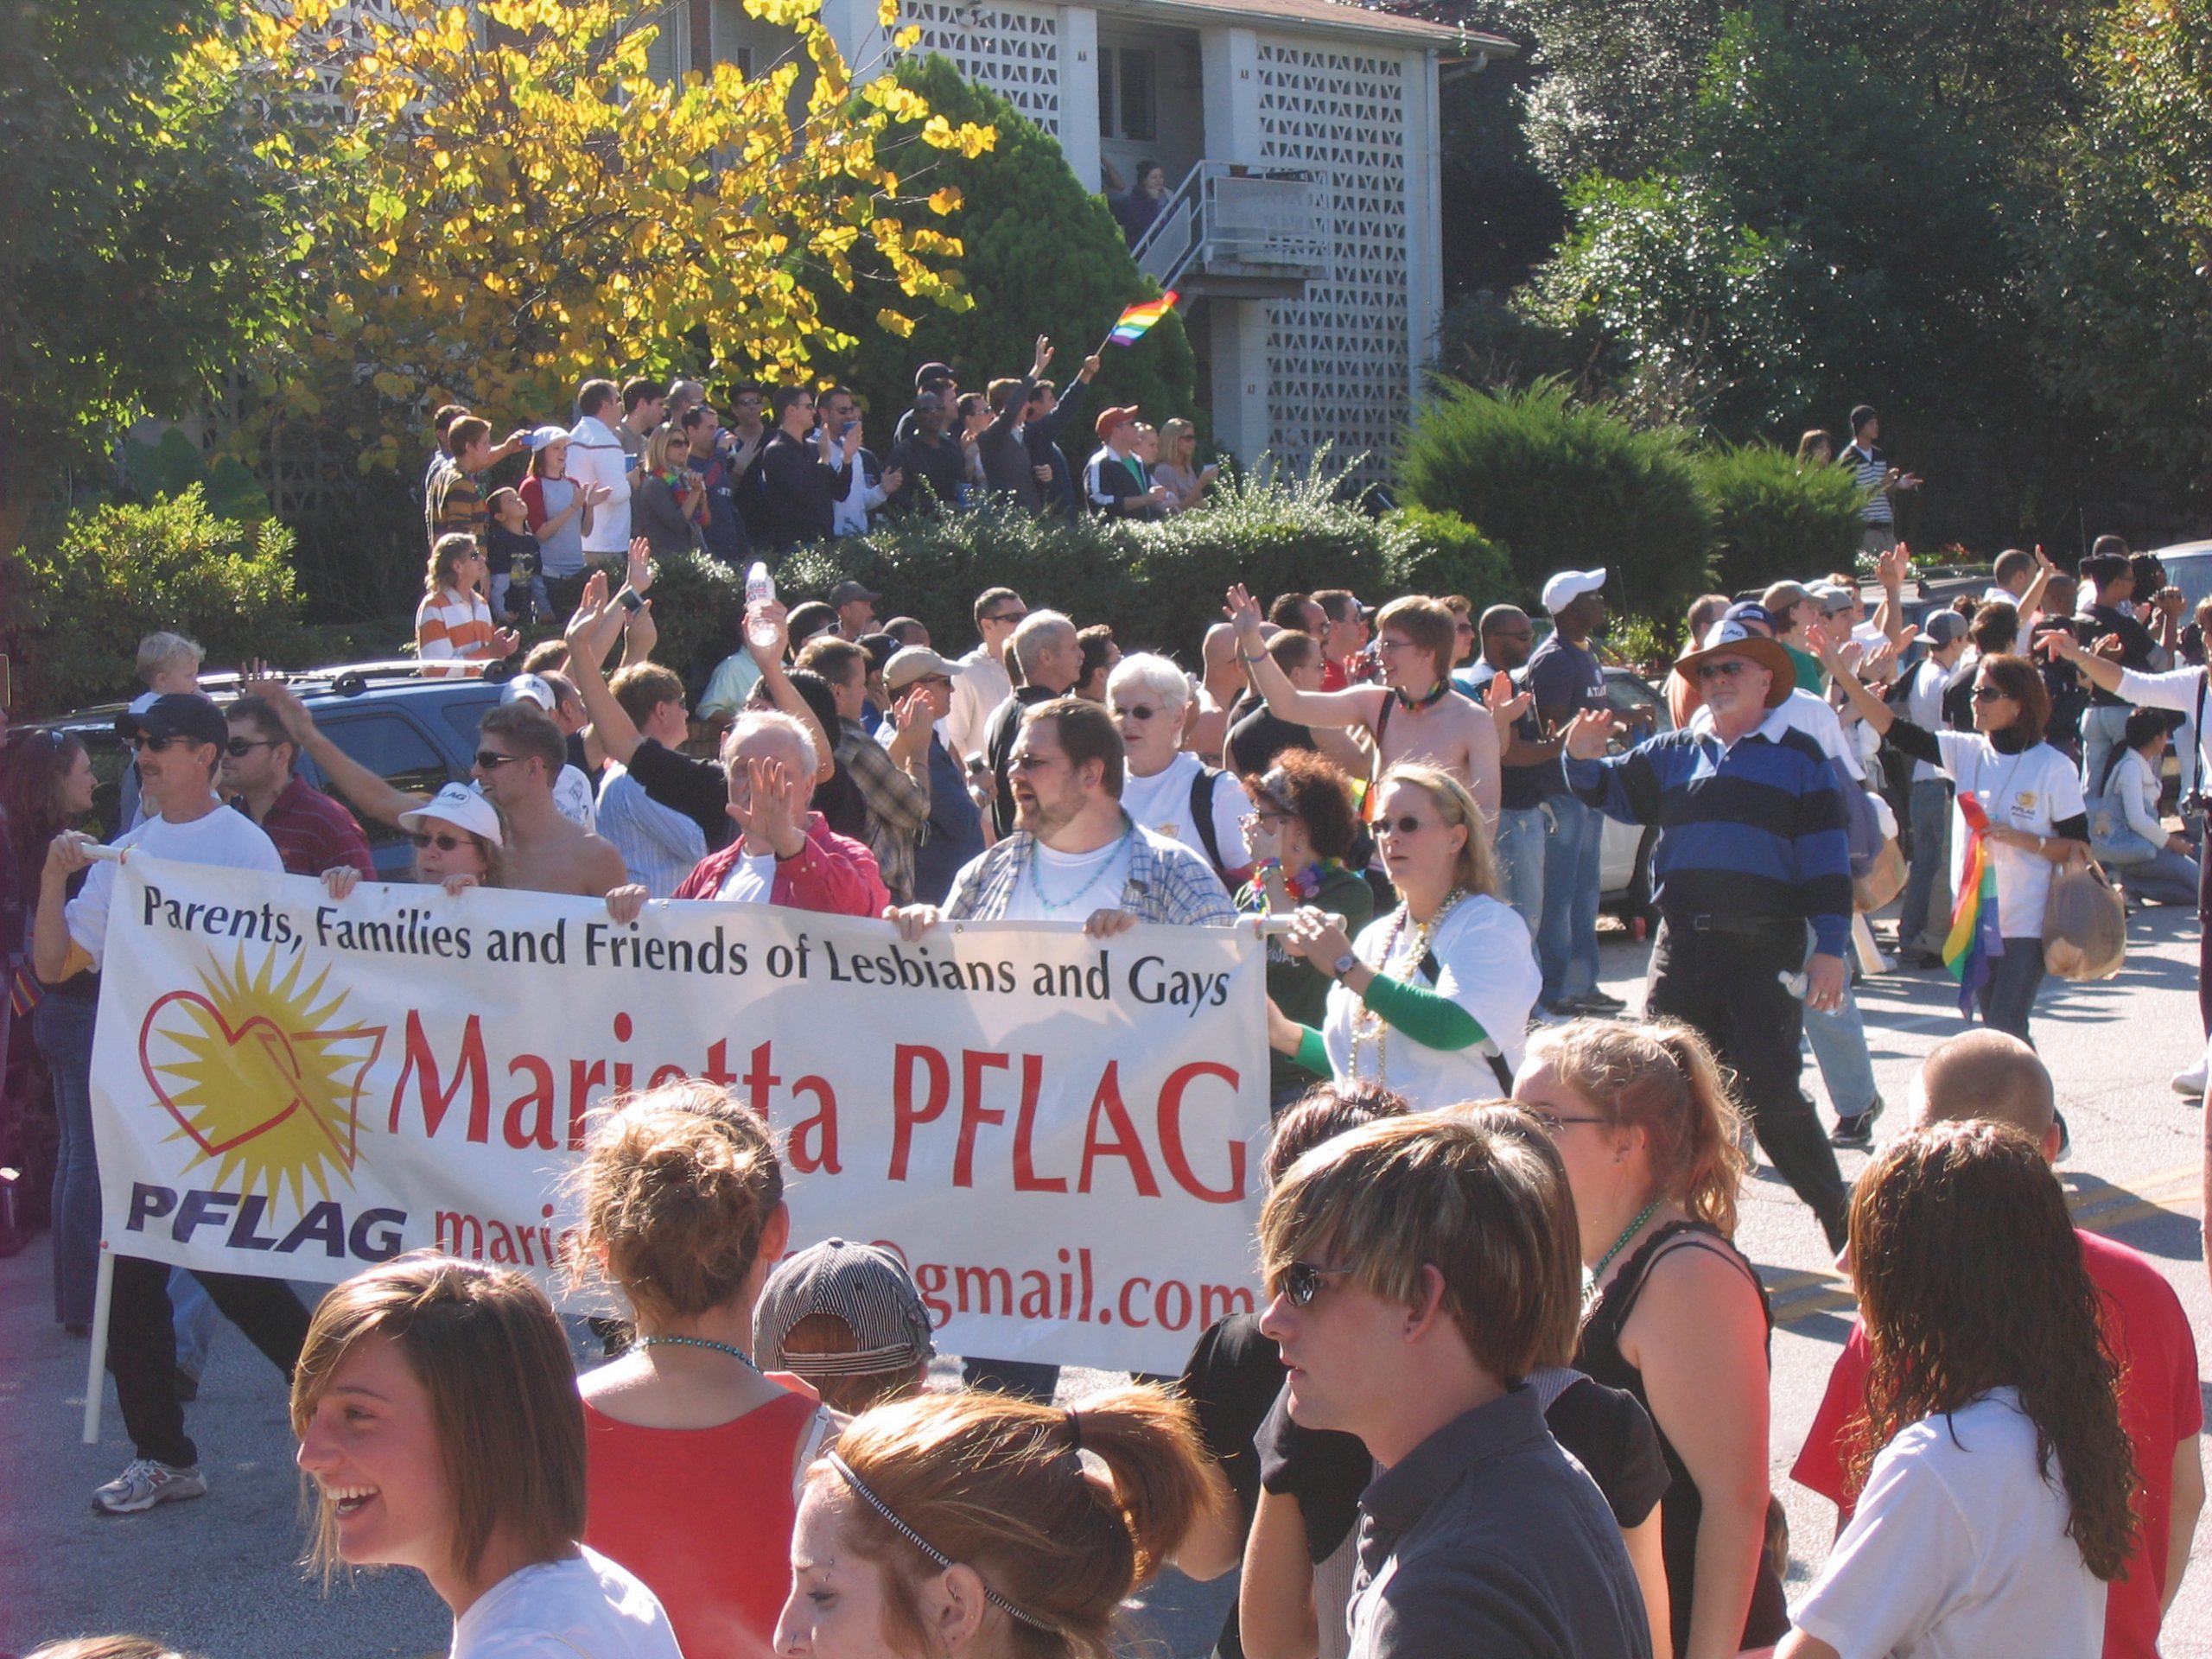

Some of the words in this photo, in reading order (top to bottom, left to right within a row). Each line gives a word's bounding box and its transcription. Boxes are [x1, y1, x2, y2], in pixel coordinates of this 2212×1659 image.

[143, 886, 304, 954] Parents,
[316, 906, 471, 958] Families
[486, 918, 566, 964] and
[586, 922, 748, 976] Friends
[766, 934, 810, 978] of
[824, 941, 1014, 992] Lesbians
[1033, 950, 1110, 1000] and
[1128, 956, 1230, 1017] Gays
[887, 1044, 1247, 1204] PFLAG
[125, 1182, 407, 1262] PFLAG
